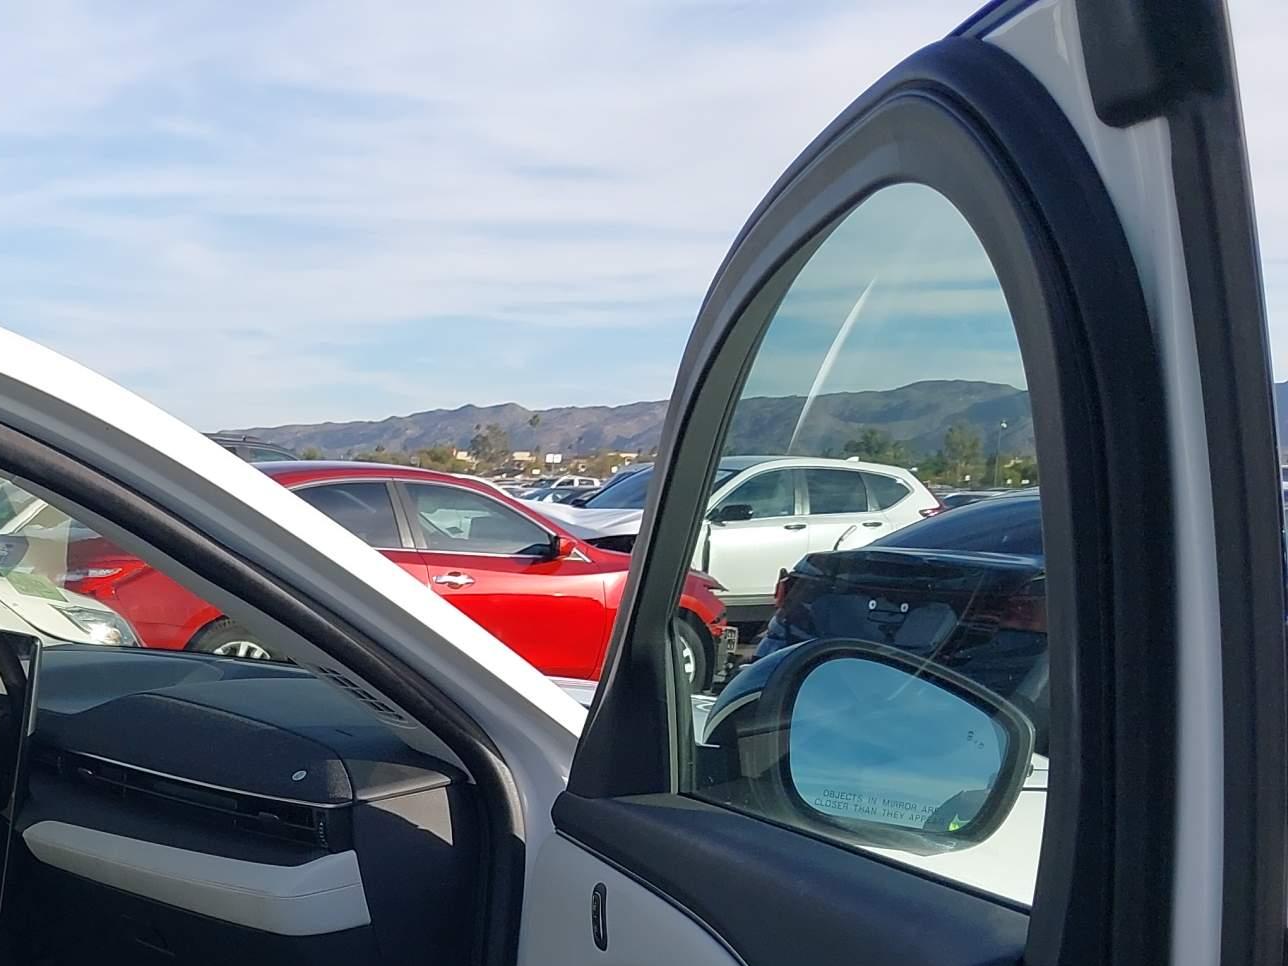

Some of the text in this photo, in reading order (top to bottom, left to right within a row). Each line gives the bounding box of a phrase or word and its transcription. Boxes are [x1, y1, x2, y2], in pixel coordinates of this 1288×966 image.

[814, 799, 848, 810] CLOSER
[854, 803, 877, 815] THAN
[882, 808, 904, 819] THEY
[823, 789, 863, 803] OBJECTS
[868, 797, 877, 805] IN
[882, 799, 917, 811] MIRROR
